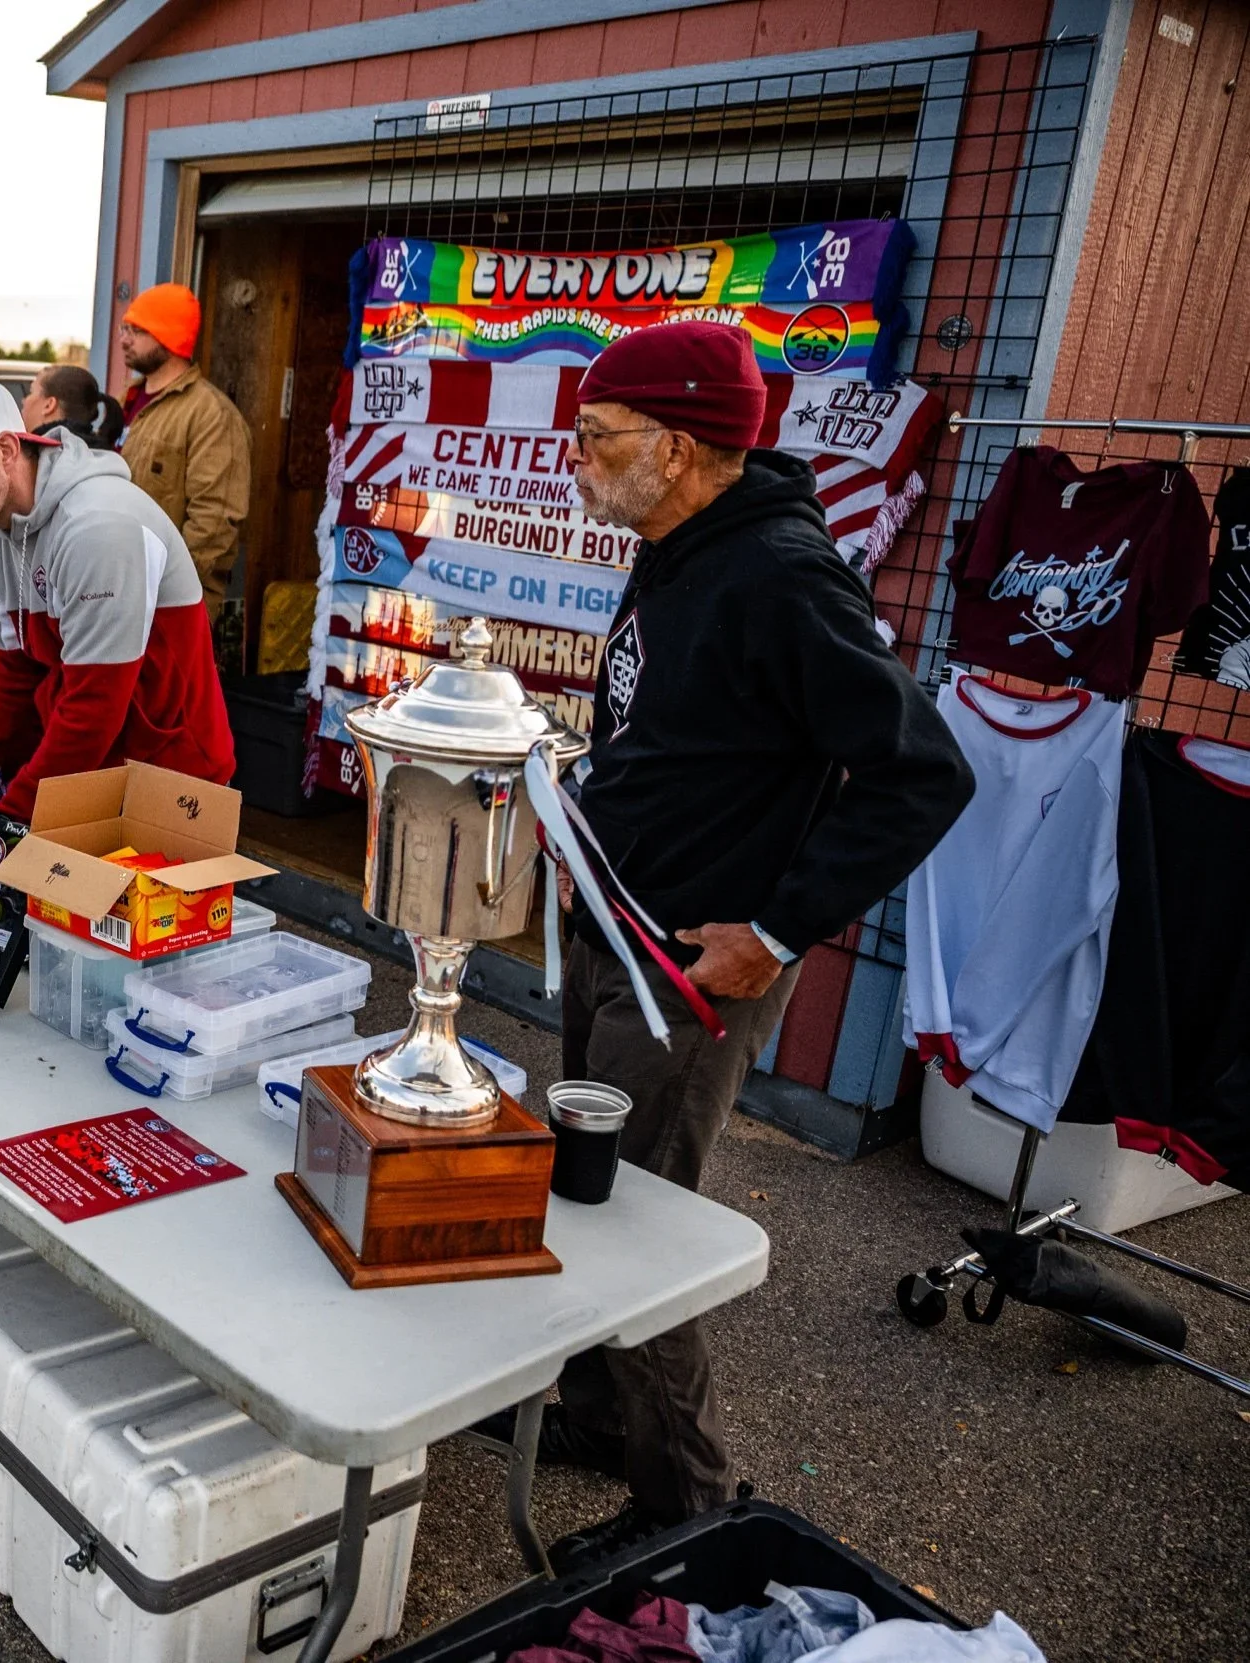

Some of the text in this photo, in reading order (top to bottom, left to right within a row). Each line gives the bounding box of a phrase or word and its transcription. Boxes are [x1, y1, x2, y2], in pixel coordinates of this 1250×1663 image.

[381, 248, 400, 289] 38
[471, 248, 716, 299] EVERYONE
[819, 236, 851, 289] 38
[474, 318, 520, 342] THESE
[521, 307, 577, 334] RAPIDS
[578, 310, 611, 337] ARE
[648, 306, 744, 327] ERYONE
[792, 342, 831, 362] 38
[355, 484, 374, 511] 38
[408, 464, 574, 505] WE CAME TO DRINK,
[346, 535, 359, 563] 38
[454, 513, 575, 556] BURGUNDY
[86, 591, 114, 601] Columbia
[428, 558, 497, 594] KEEP
[508, 575, 546, 604] ON
[340, 747, 355, 784] 38
[211, 907, 228, 921] 11h
